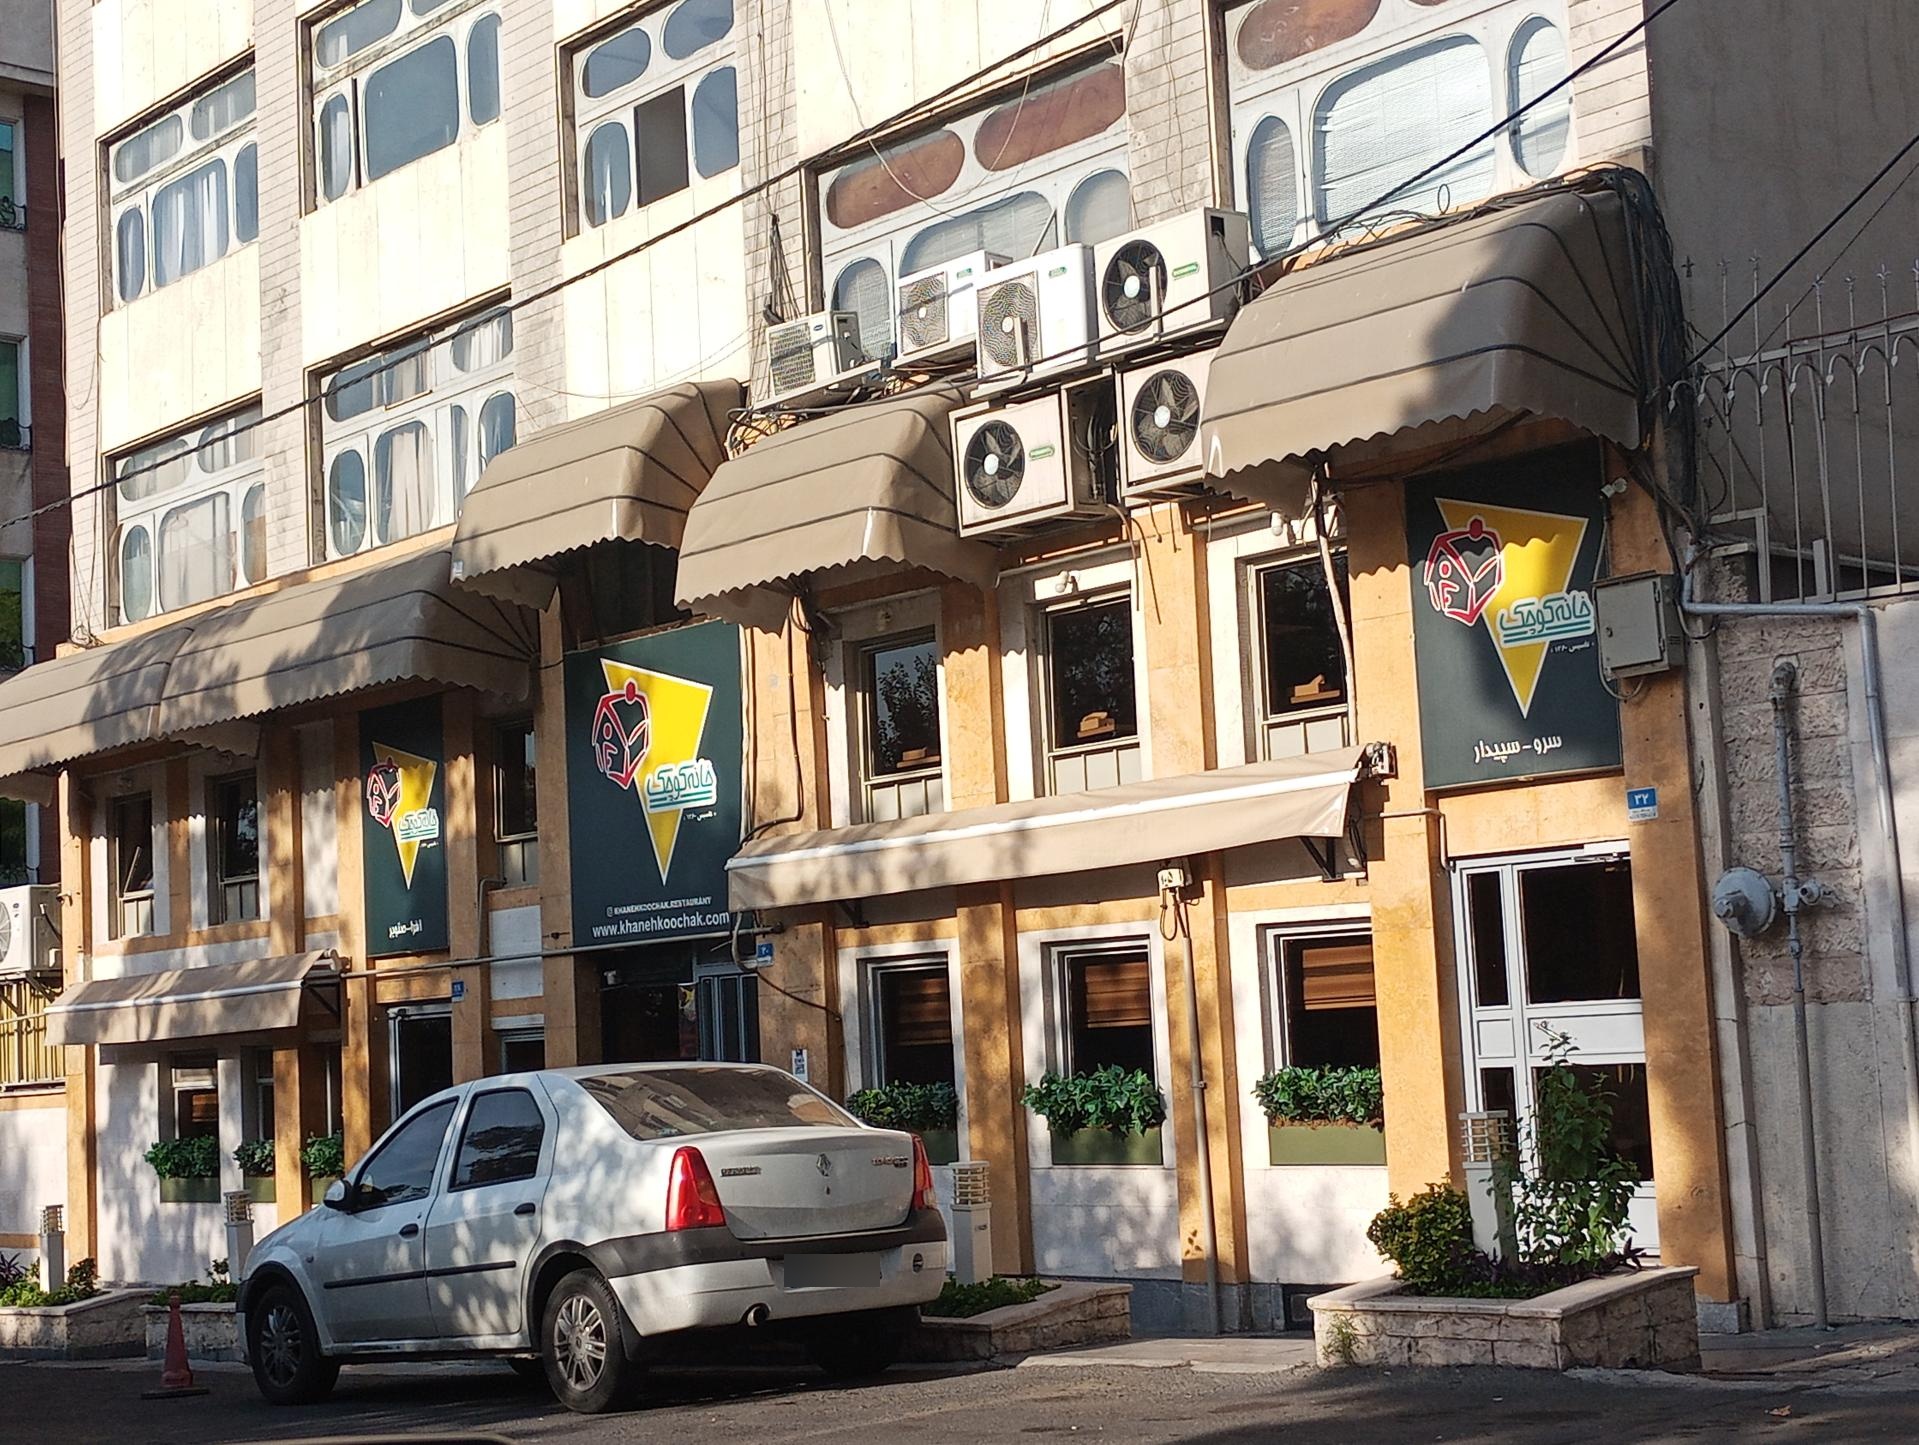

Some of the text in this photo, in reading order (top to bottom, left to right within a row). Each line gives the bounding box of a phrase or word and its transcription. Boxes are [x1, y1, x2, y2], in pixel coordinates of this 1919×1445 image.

[1499, 594, 1591, 636] خانه کوچک
[646, 762, 714, 802] خانه کوچک
[592, 912, 730, 937] www.khanehkoochak.com
